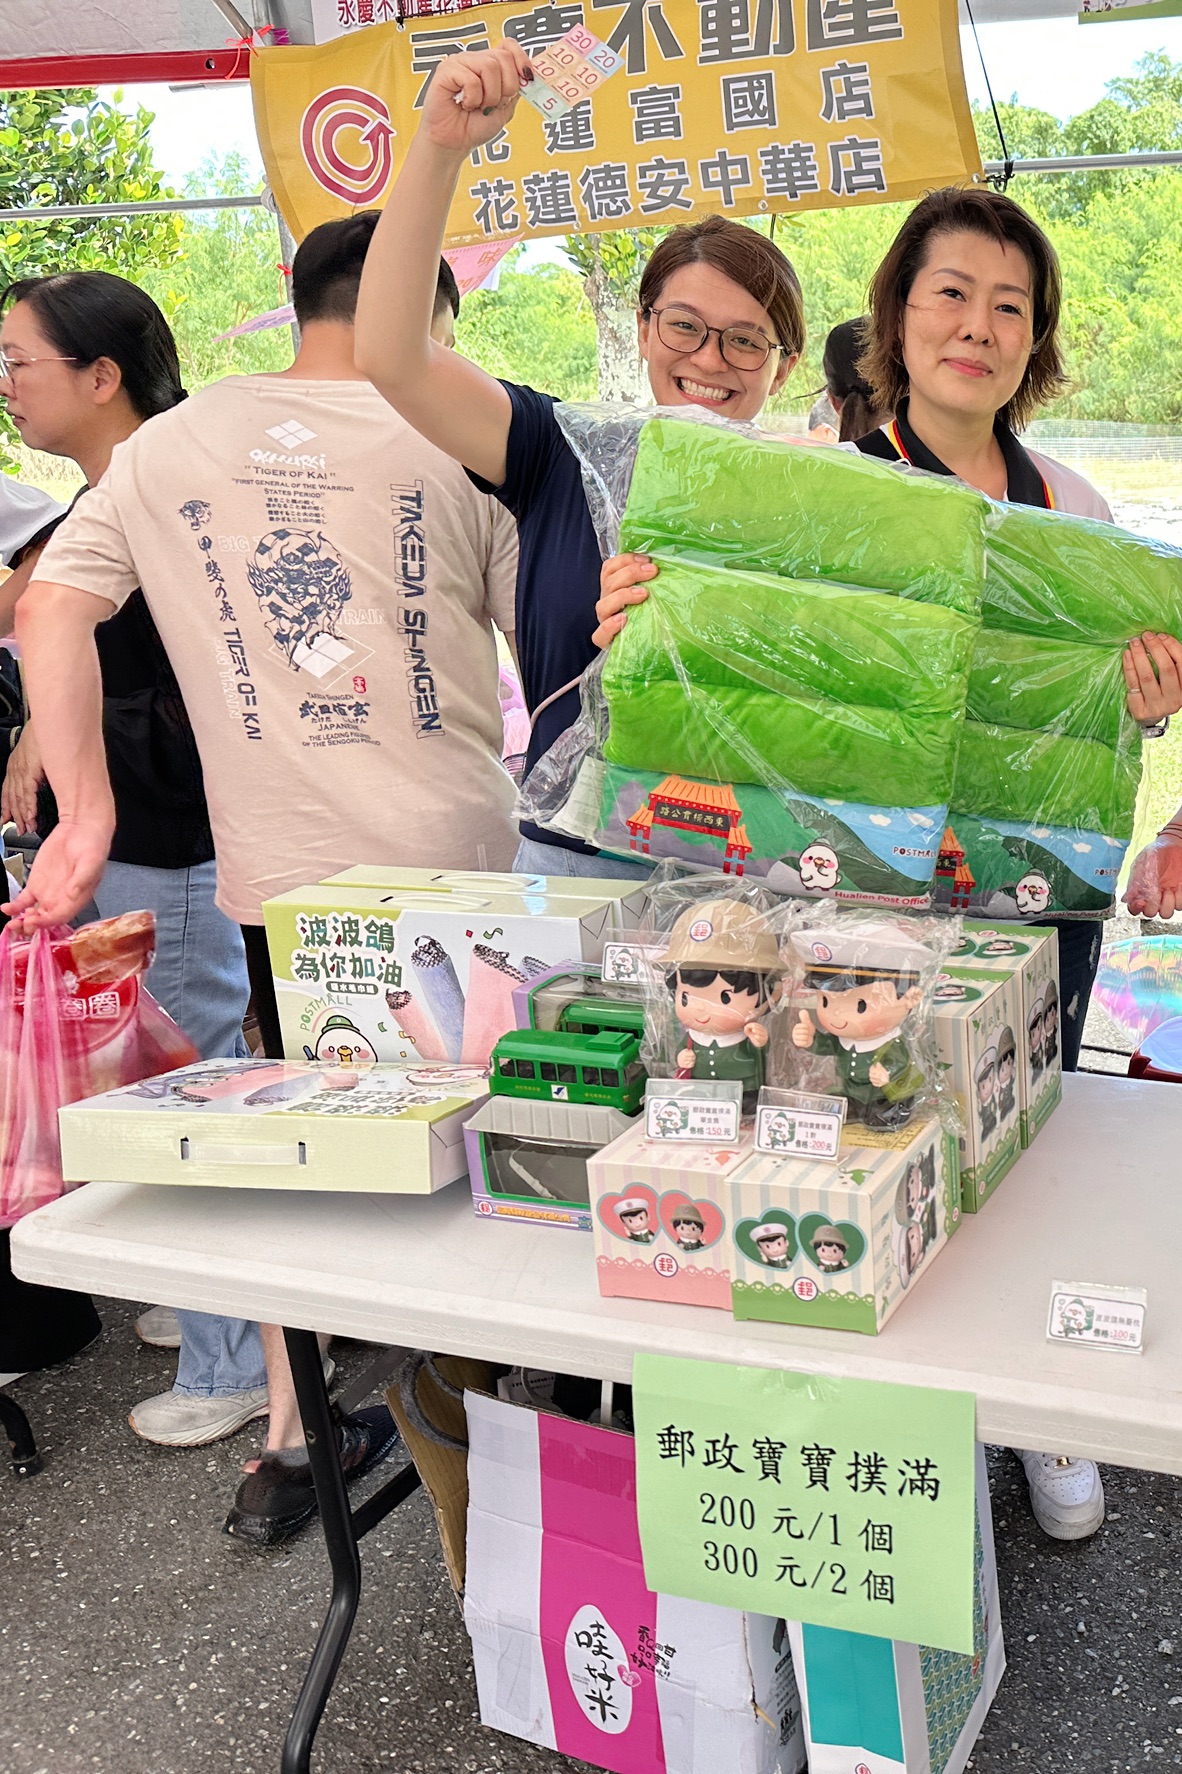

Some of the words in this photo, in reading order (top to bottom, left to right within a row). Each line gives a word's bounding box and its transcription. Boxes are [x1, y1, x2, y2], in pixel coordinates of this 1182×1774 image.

[570, 30, 592, 50] 30
[553, 47, 575, 65] 10
[594, 49, 616, 69] 20
[533, 60, 555, 77] 10
[576, 67, 598, 86] 10
[557, 80, 579, 98] 10
[542, 97, 558, 111] 5
[472, 136, 888, 238] 花蓮德安中華店
[253, 466, 287, 477] TIGER
[289, 470, 304, 478] OF
[307, 471, 328, 480] KAI
[255, 479, 289, 488] GENERAL
[318, 484, 355, 492] WARRING
[264, 488, 292, 496] STATES
[224, 627, 250, 677] TIGER
[237, 682, 257, 706] OF
[242, 712, 262, 740] KAI
[834, 890, 876, 902] Hualien
[877, 894, 900, 905] Post
[299, 915, 395, 954] 波波鴿
[294, 951, 403, 988] 為你加油
[299, 993, 354, 1032] POSTMALL
[655, 1423, 942, 1502] 郵政寶寶撲滿
[698, 1492, 756, 1531] 200
[857, 1517, 894, 1556] 個
[703, 1540, 759, 1579] 300
[858, 1568, 896, 1606] 個
[574, 1620, 620, 1724] 哇好米
